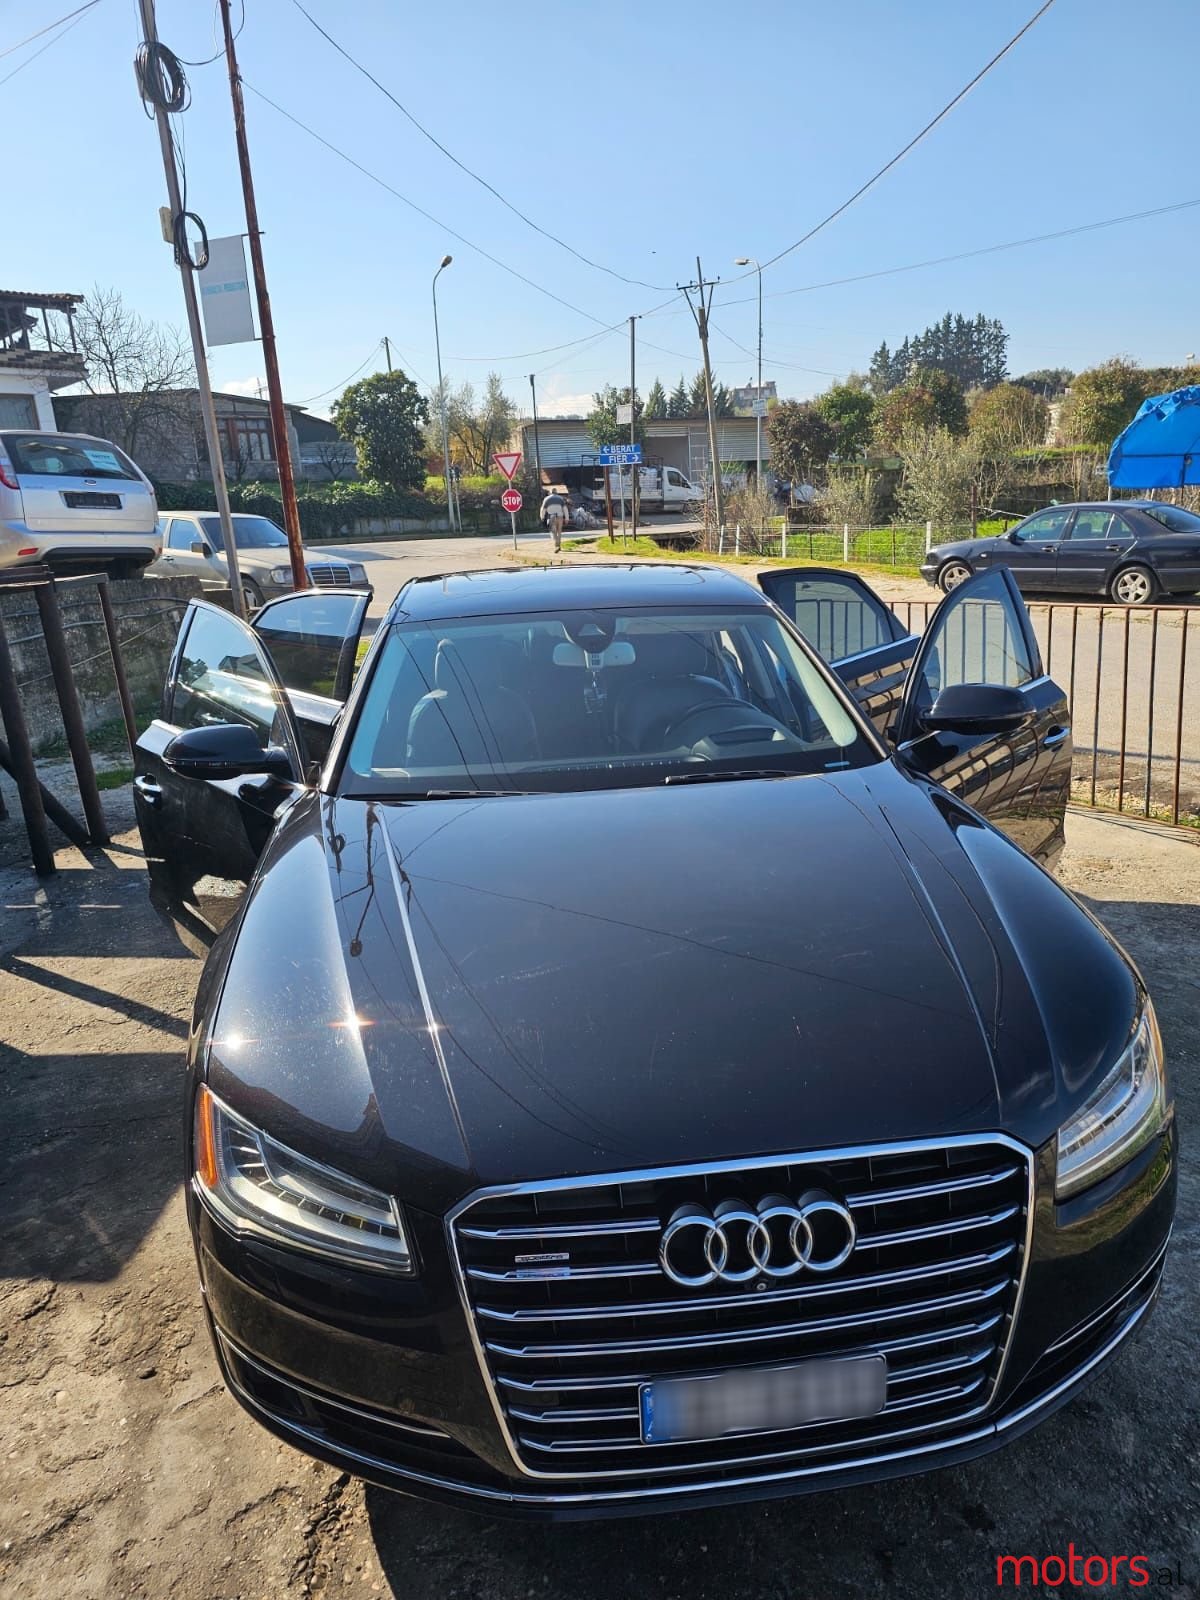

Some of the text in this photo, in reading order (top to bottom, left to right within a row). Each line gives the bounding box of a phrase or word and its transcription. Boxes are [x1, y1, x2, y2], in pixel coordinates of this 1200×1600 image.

[611, 445, 635, 453] BERAT
[609, 455, 627, 463] FIER
[503, 496, 521, 506] STOP
